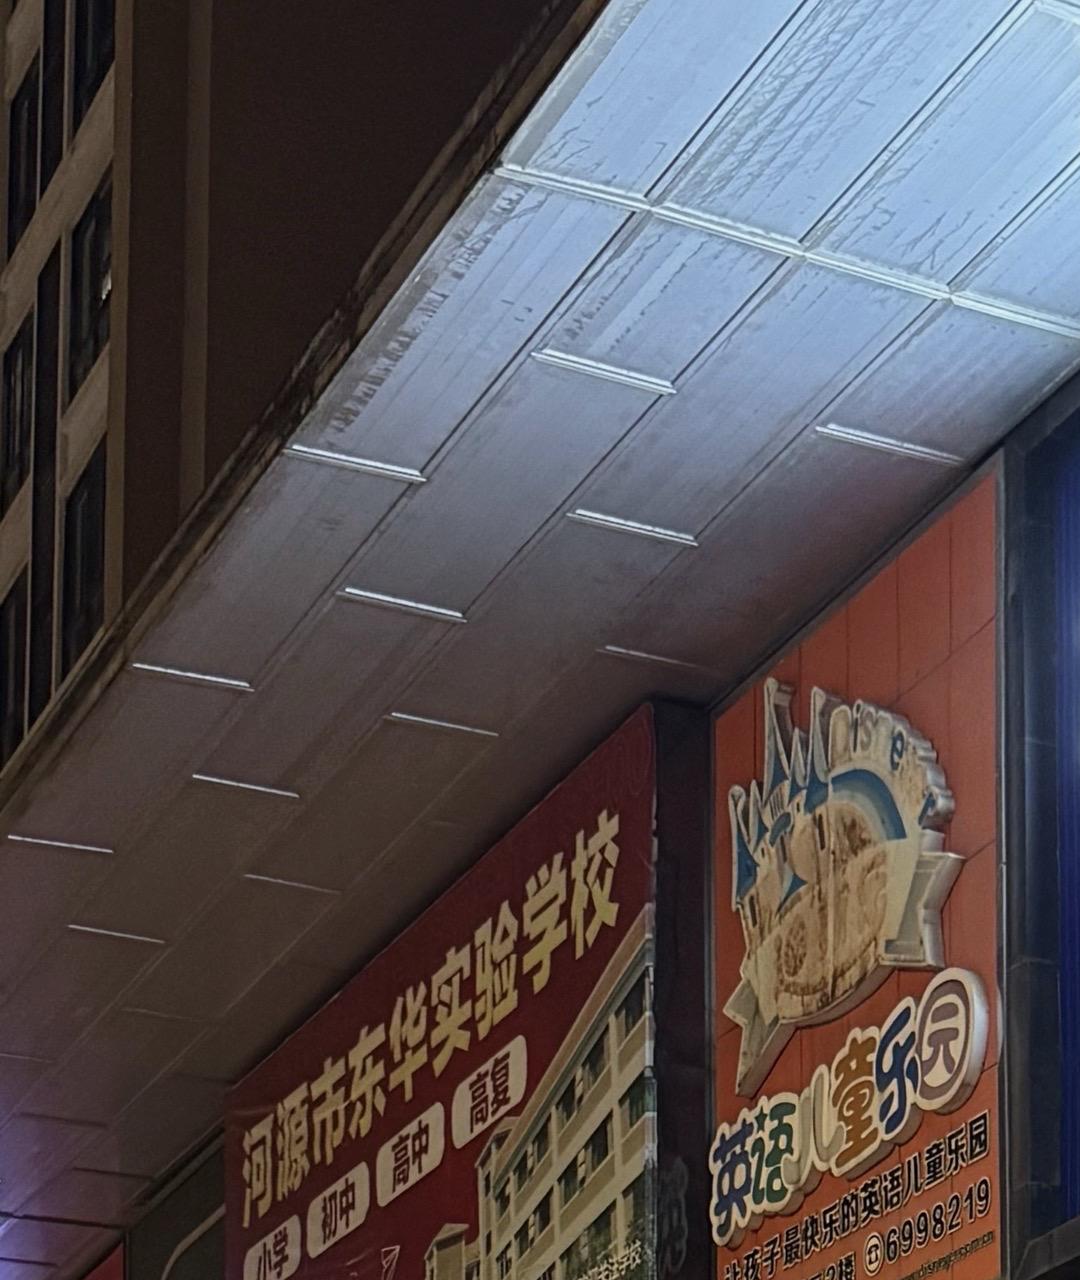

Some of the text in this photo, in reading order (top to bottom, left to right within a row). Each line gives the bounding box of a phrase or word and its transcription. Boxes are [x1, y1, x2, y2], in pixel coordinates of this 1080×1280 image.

[240, 810, 622, 1227] 河源市东华实验学校
[468, 1057, 514, 1133] 高复
[713, 978, 972, 1238] 英语儿童乐园
[390, 1120, 431, 1195] 高中
[320, 1183, 359, 1247] 初中
[884, 1180, 991, 1262] 6998219
